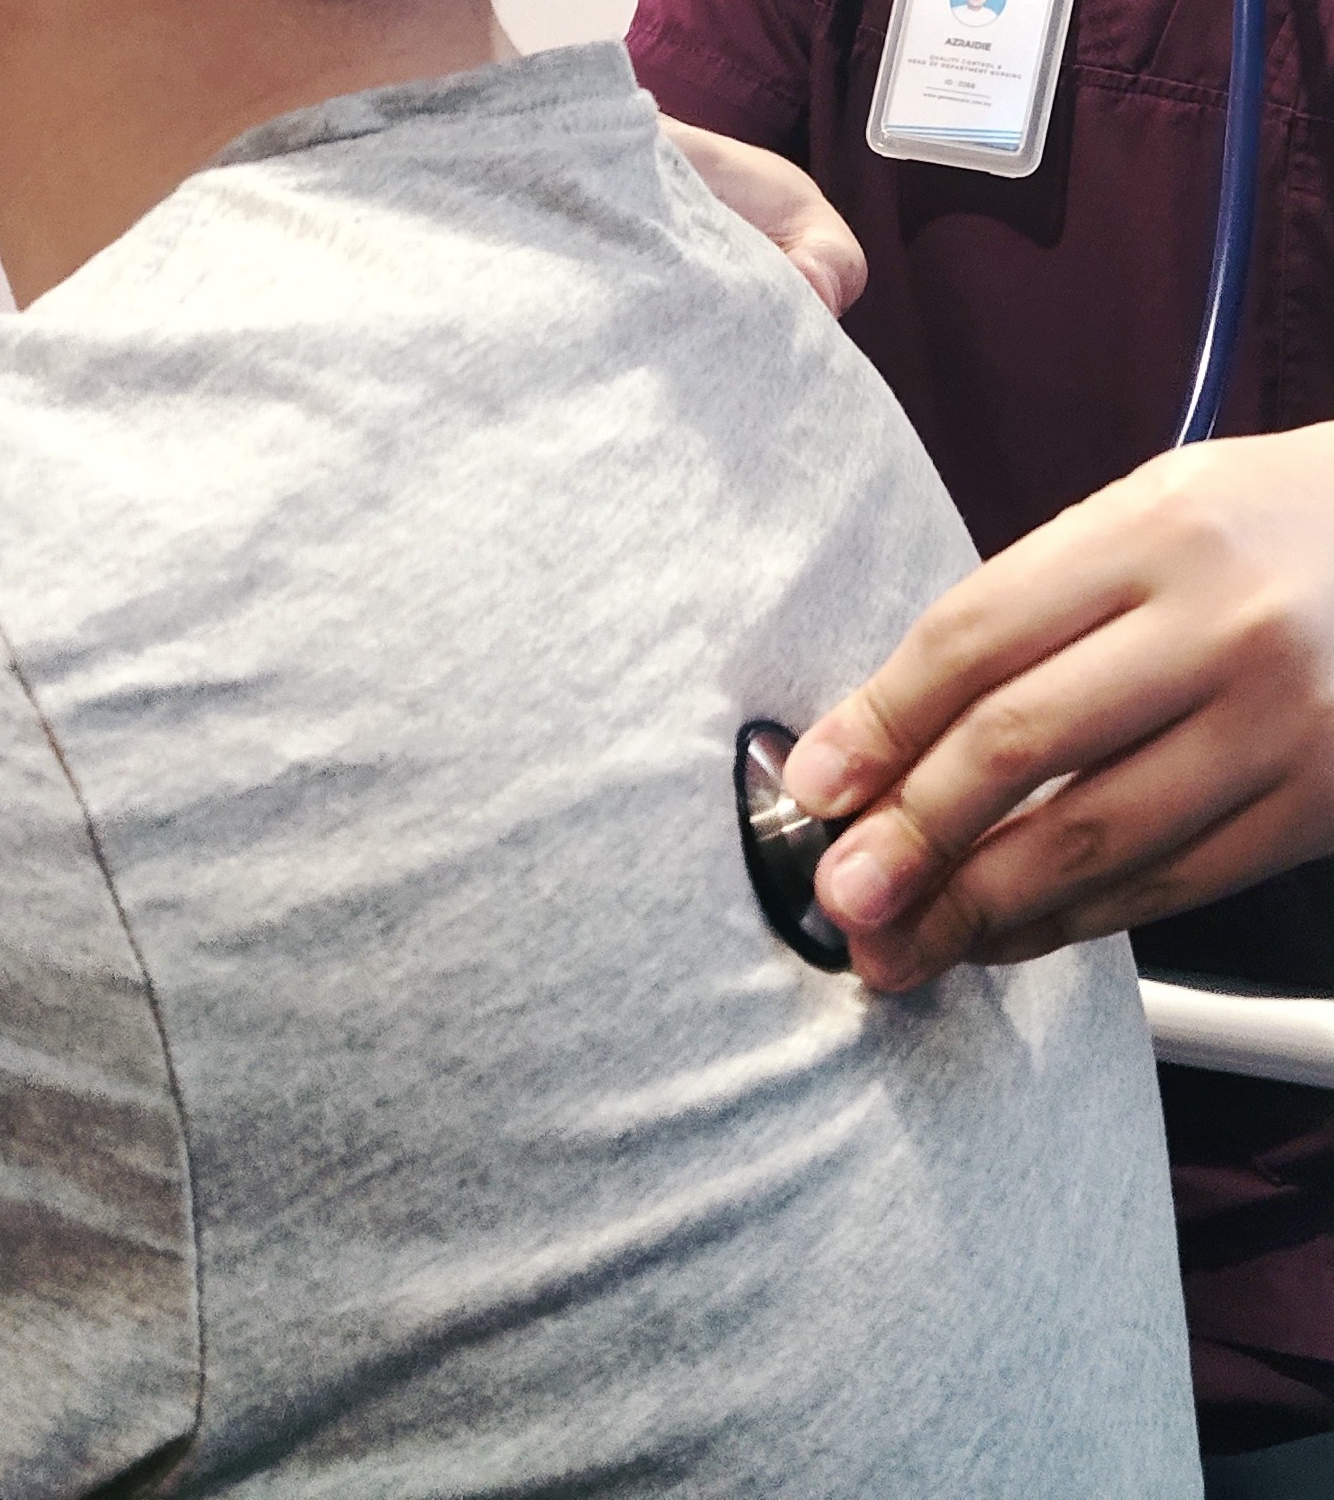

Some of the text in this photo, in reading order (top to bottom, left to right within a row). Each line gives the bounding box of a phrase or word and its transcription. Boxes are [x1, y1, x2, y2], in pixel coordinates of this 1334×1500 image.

[945, 37, 992, 51] AZRAIDIE
[929, 54, 959, 63] QUALITY
[962, 58, 995, 69] CONTROL
[941, 62, 988, 74] DEPARTMENT
[990, 70, 1022, 79] NURSING
